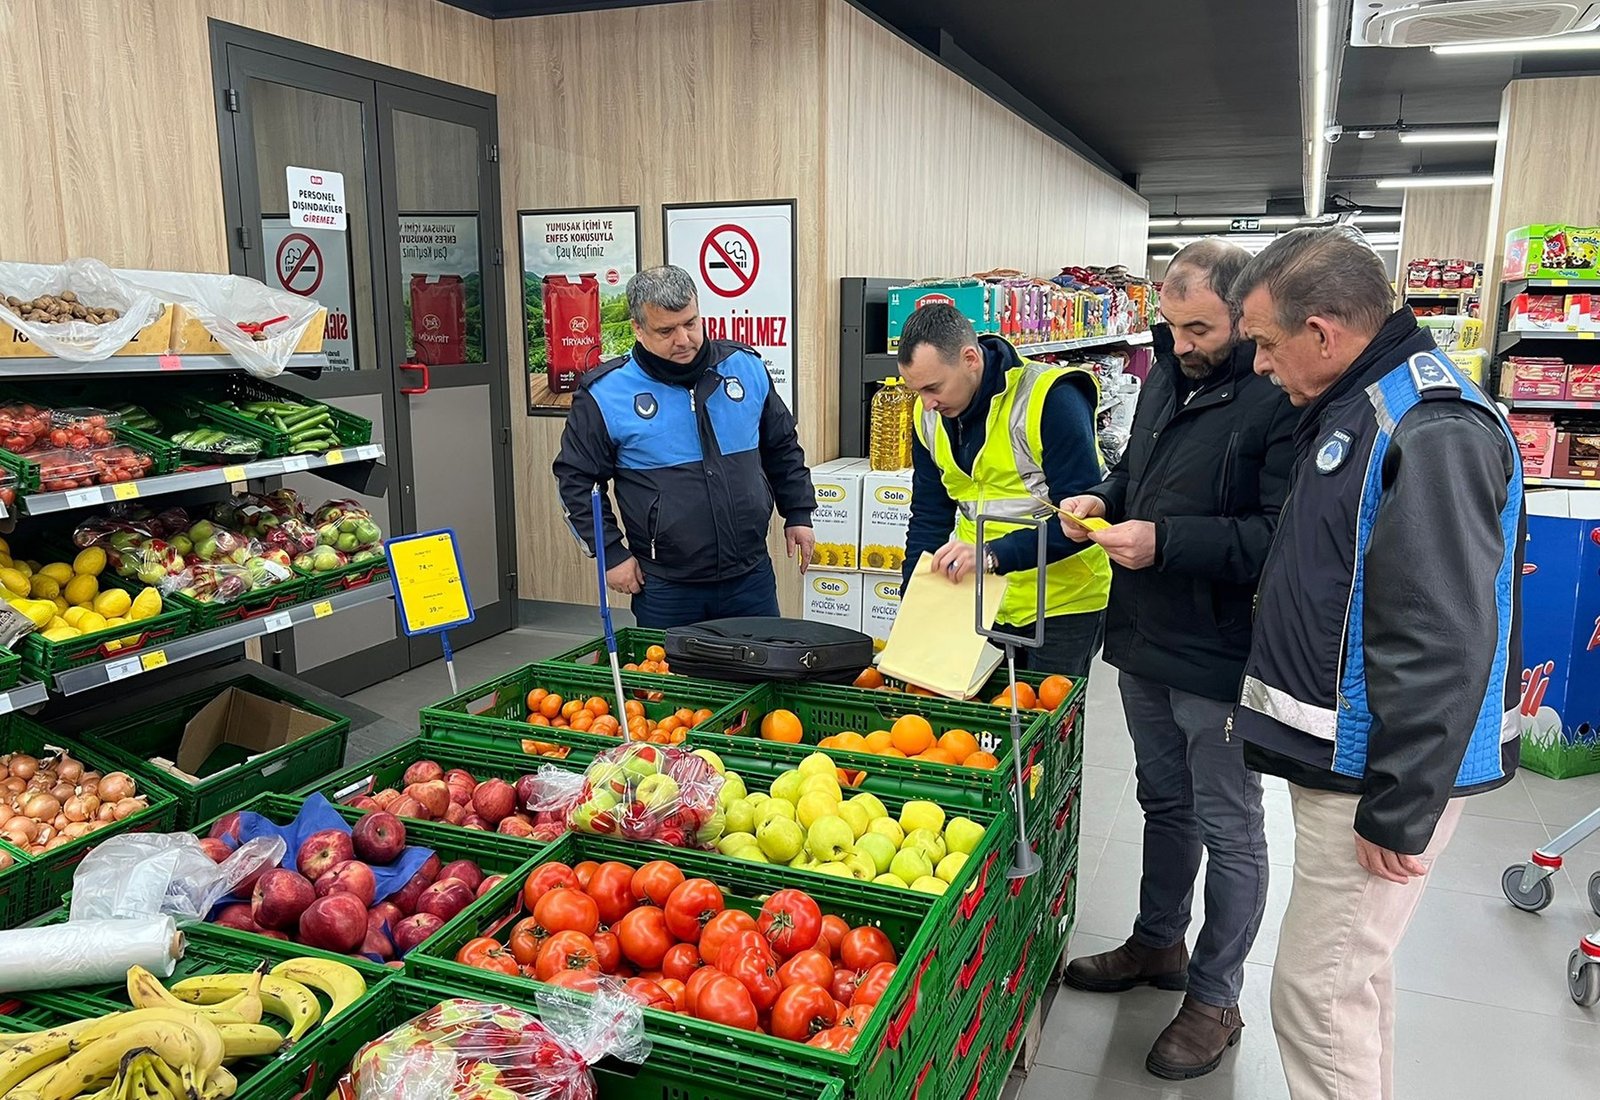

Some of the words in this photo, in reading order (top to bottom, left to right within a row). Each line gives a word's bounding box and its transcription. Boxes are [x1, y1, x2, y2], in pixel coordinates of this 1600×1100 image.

[299, 190, 336, 201] PERSONEL
[583, 219, 601, 232] İÇİMİ
[603, 221, 613, 230] VE
[546, 234, 568, 243] ENFES
[571, 232, 614, 242] KOKUSUYLA
[556, 245, 571, 260] Çay
[573, 244, 604, 259] Keyfiniz
[562, 335, 594, 346] TİRYAKİM
[818, 489, 837, 497] Sole
[884, 491, 904, 500] Sole
[821, 582, 840, 591] Sole
